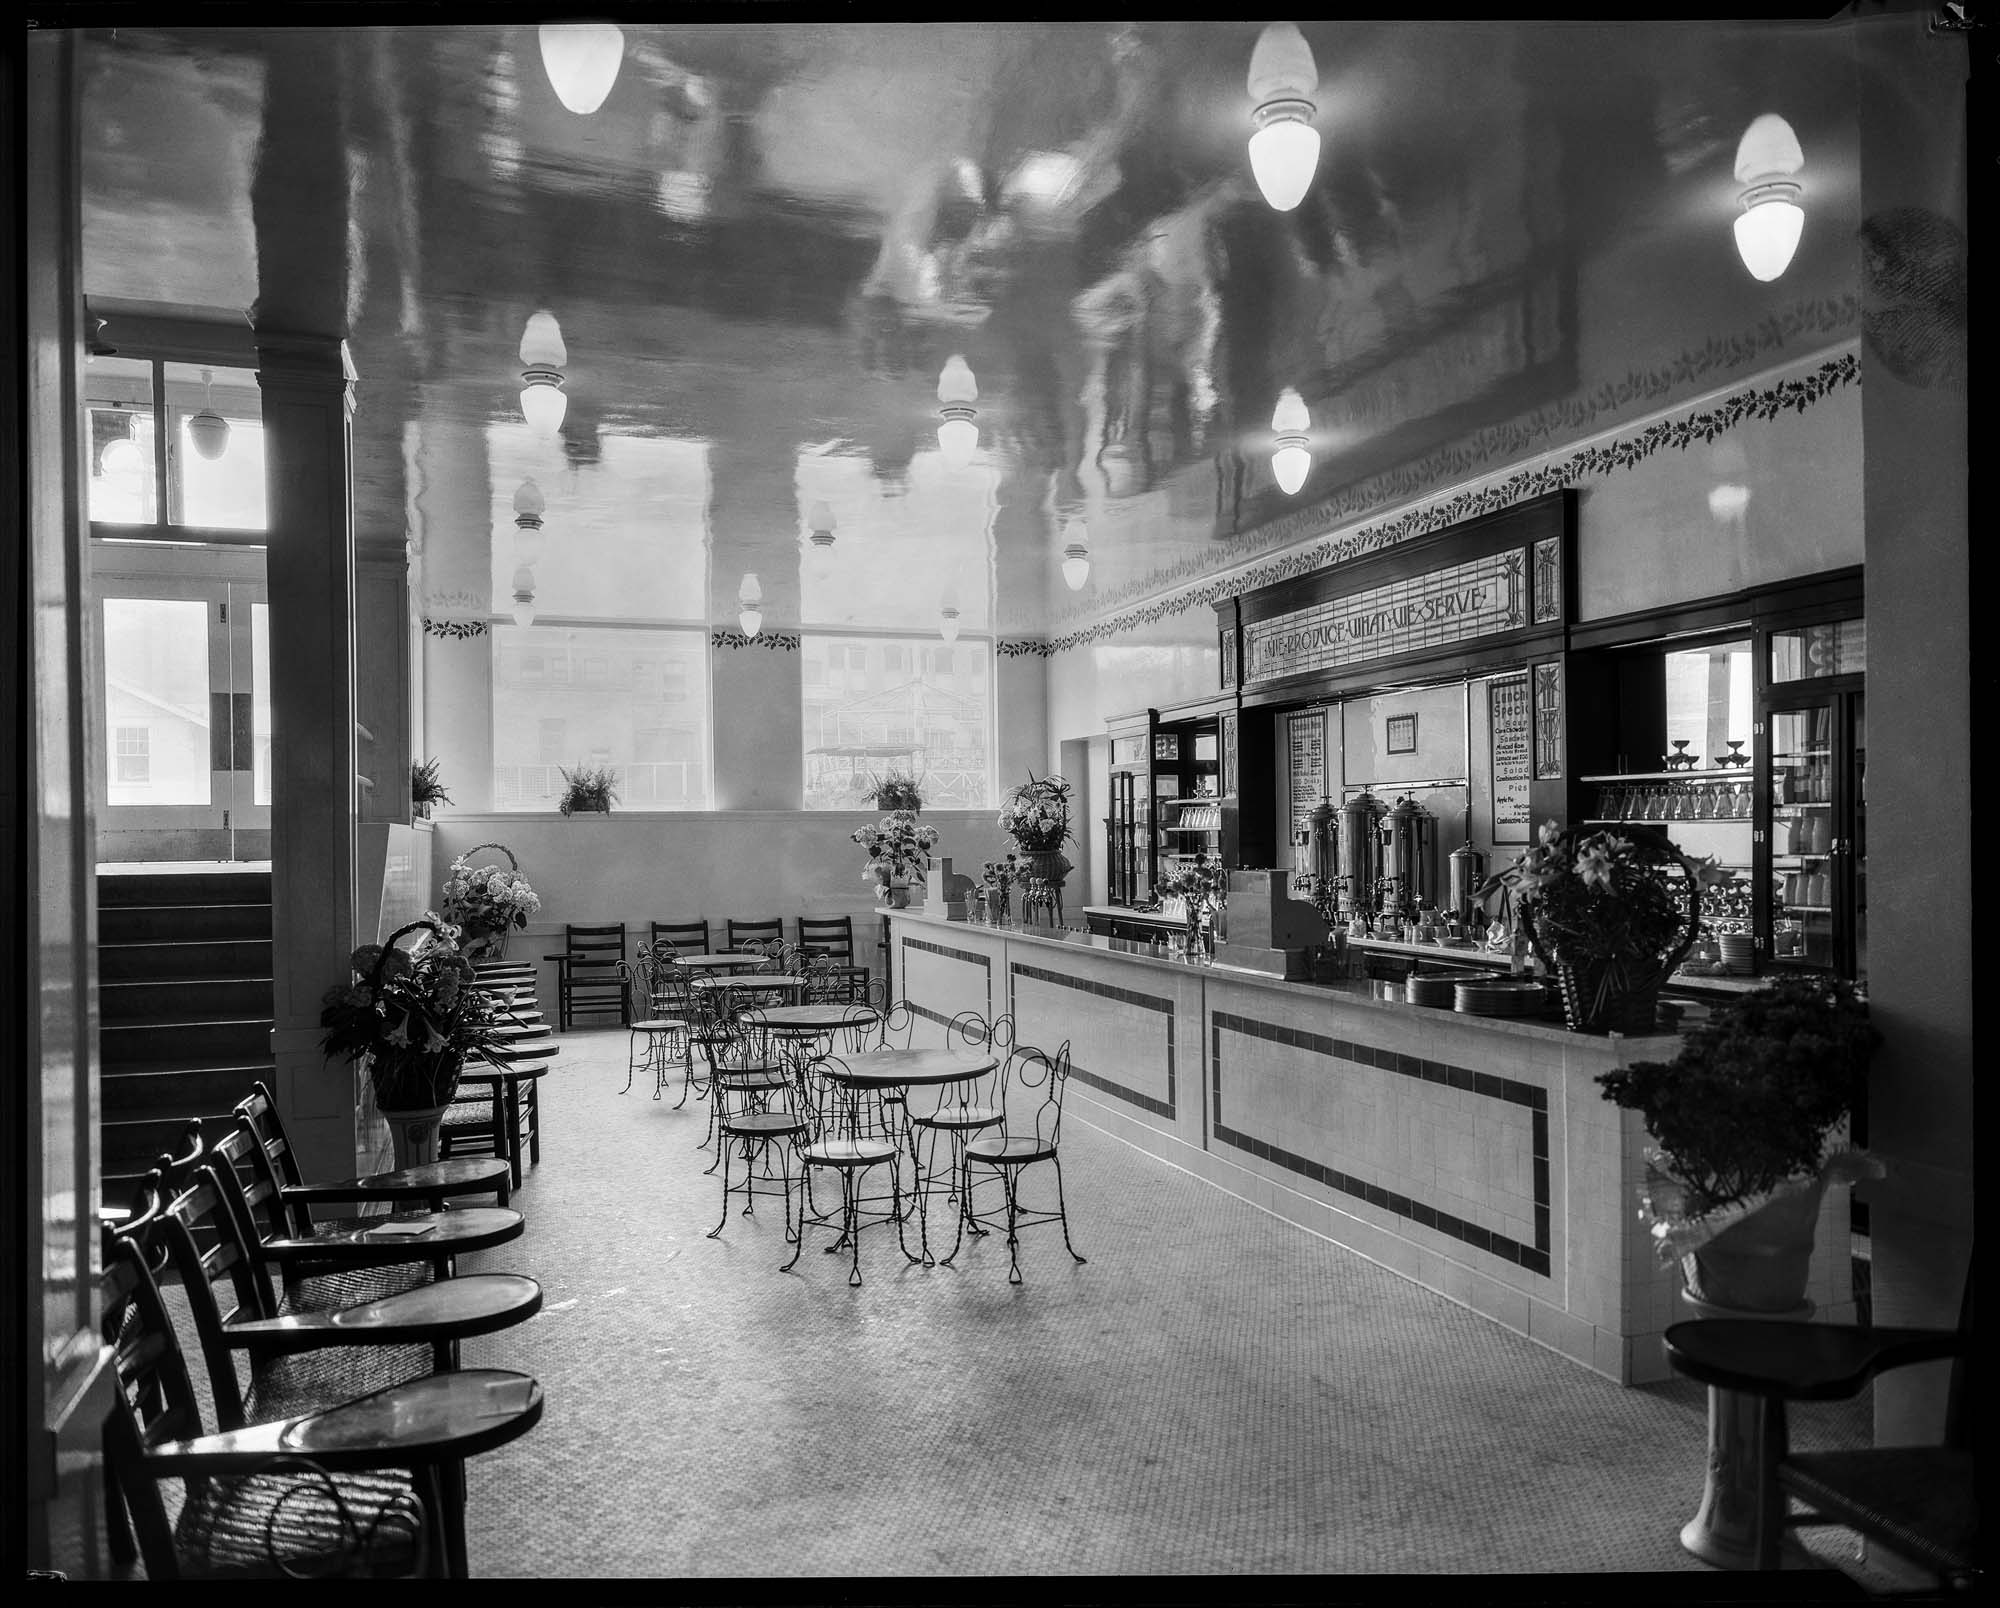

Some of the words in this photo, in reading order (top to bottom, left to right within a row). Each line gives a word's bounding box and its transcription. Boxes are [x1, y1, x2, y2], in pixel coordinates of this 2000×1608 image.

[1267, 636, 1284, 657] WE
[1287, 622, 1346, 653] PRODUCE
[1348, 609, 1390, 638] WHAT
[1393, 603, 1415, 629] WE
[1424, 588, 1482, 621] SERVE
[1509, 782, 1528, 791] Pies
